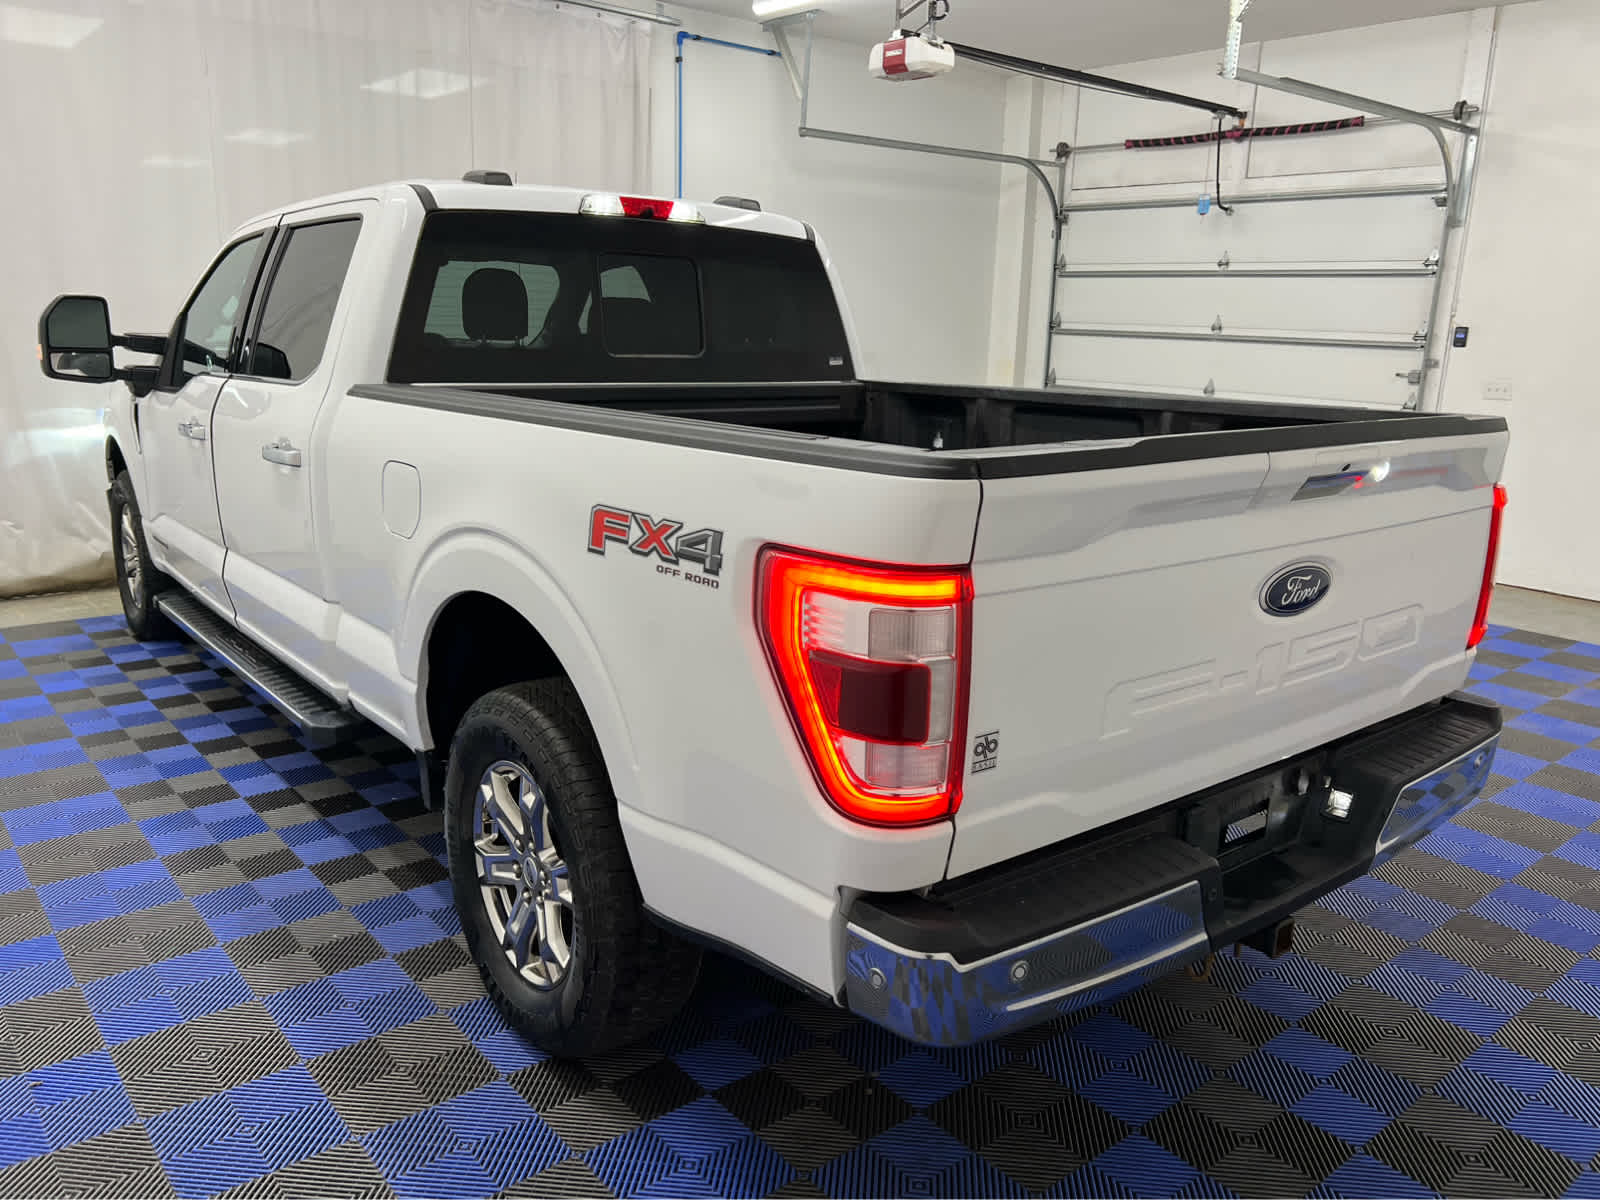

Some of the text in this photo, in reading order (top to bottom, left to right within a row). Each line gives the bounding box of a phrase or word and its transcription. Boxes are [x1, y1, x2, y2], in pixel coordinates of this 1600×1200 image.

[588, 504, 724, 576] FX4
[655, 564, 720, 589] OFF ROAD
[1280, 575, 1321, 606] Ford
[1101, 604, 1423, 738] F-150
